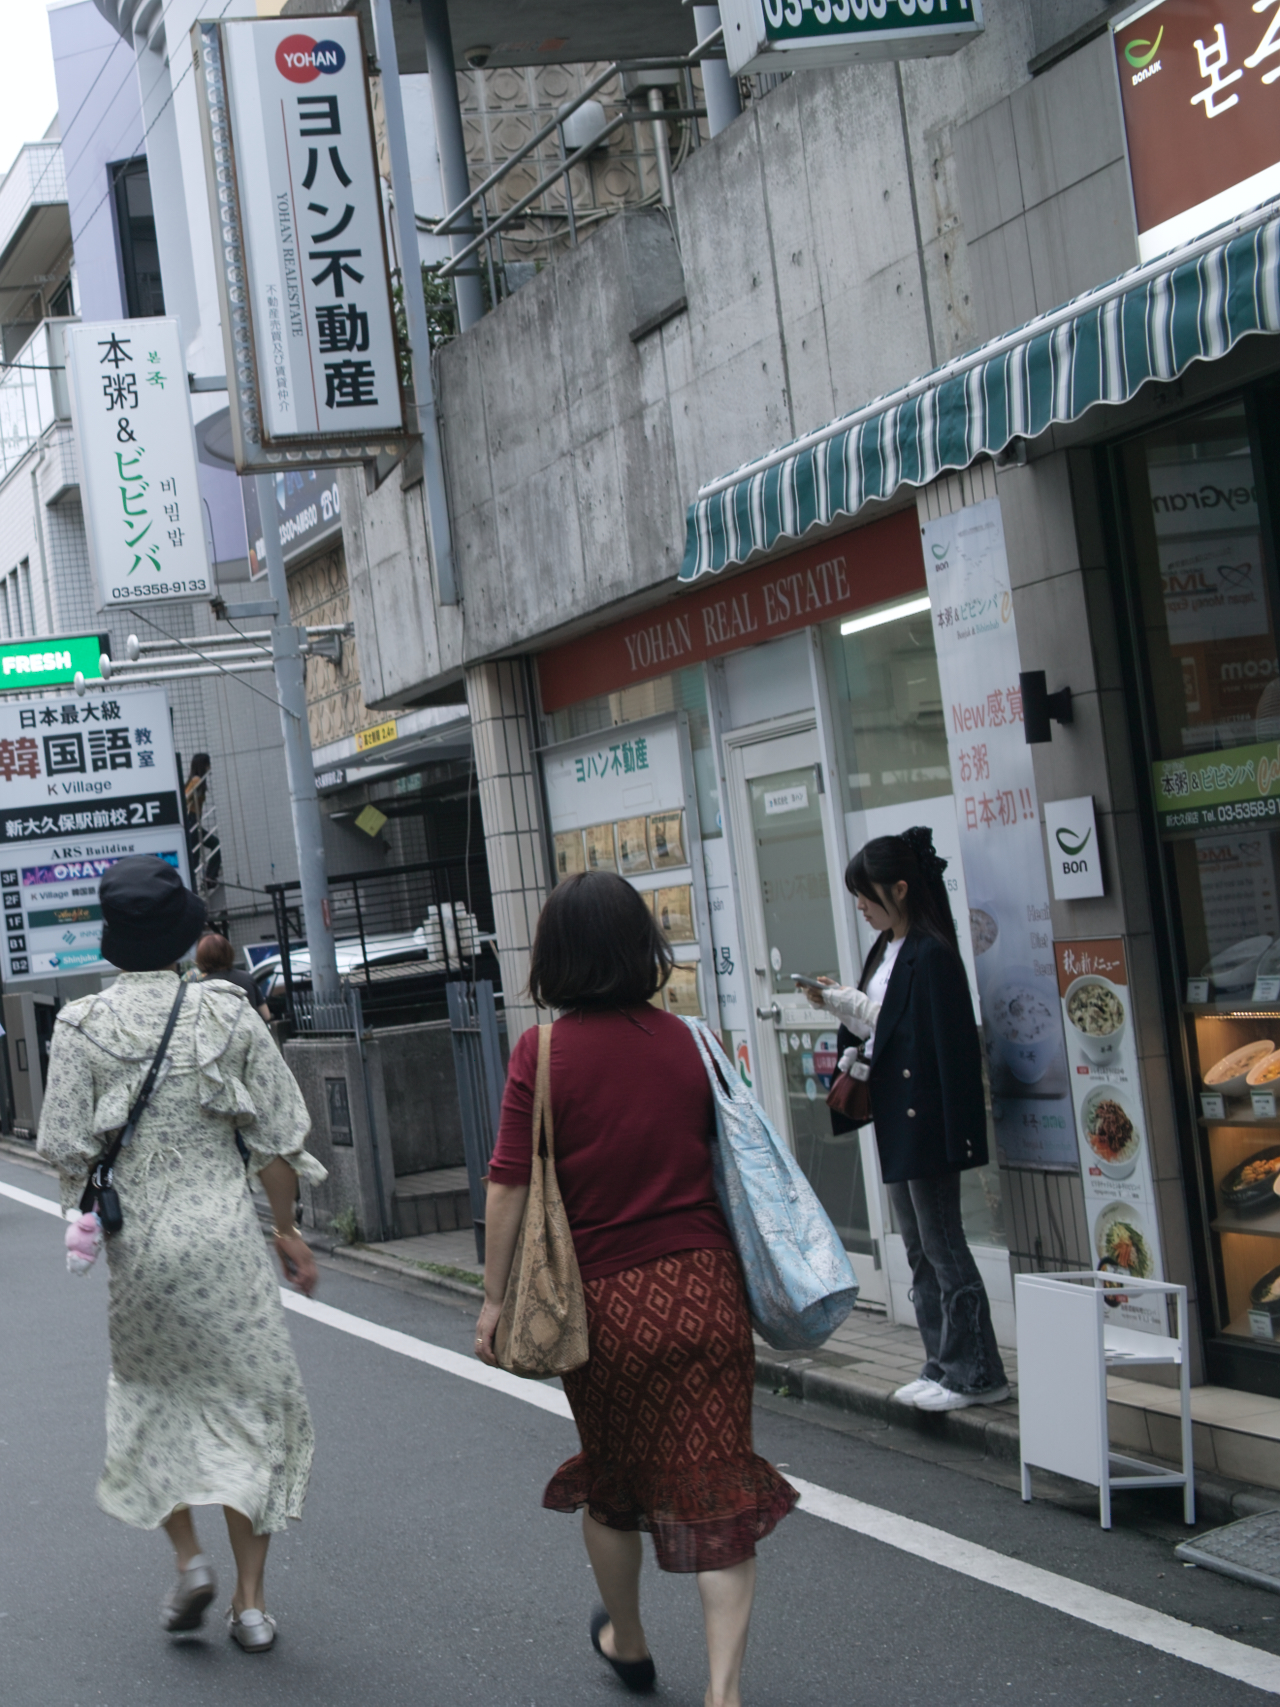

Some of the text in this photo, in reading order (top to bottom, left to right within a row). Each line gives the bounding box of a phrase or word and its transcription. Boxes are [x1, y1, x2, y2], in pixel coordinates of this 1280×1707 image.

[283, 51, 338, 68] YOHAN
[296, 94, 380, 411] ヨハン不動産
[276, 192, 304, 338] YOHAN REALESTATE
[144, 351, 168, 390] 본죽
[160, 477, 186, 547] 비빔밥
[112, 579, 207, 599] 03-5358-9133
[625, 556, 850, 671] YOHAN REAL ESTATE
[2, 651, 72, 675] FRESH
[19, 700, 121, 730] 日本最大級
[134, 727, 155, 768] 教室
[575, 737, 649, 782] ヨハン不動産
[958, 744, 991, 783] お粥
[47, 780, 112, 796] K Village
[5, 801, 161, 838] 新大久保駅前校 2F
[50, 844, 135, 860] ARS Building
[2, 873, 17, 883] 3F
[4, 894, 19, 906] 2F
[40, 889, 69, 900] Village
[8, 915, 22, 927] 1F
[9, 938, 24, 949] B1
[11, 960, 29, 971] B2
[63, 955, 98, 965] Shinjuku
